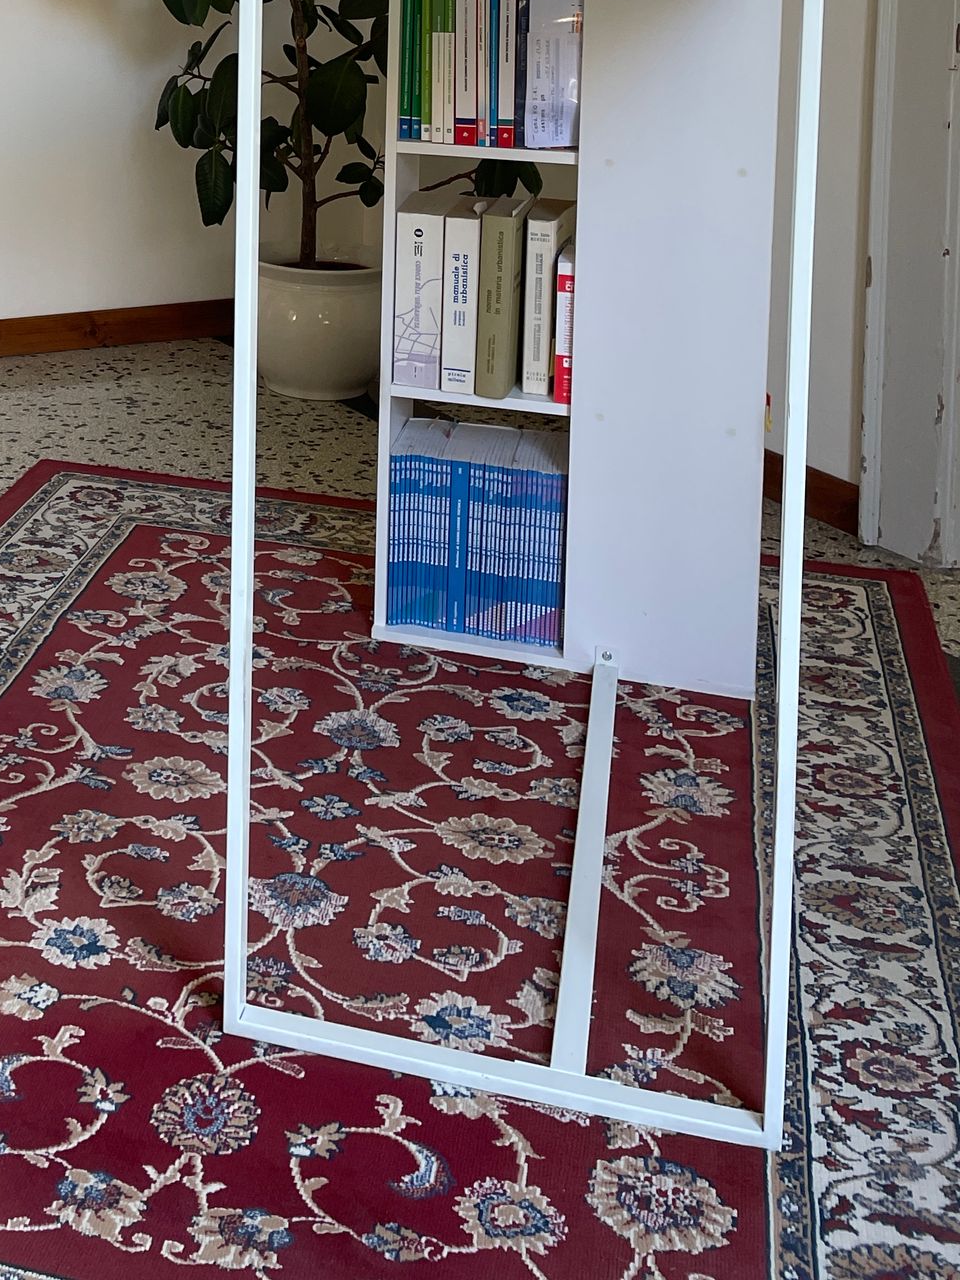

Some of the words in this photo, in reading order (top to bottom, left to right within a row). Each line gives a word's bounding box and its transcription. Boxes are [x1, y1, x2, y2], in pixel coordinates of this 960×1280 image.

[453, 253, 460, 262] di
[496, 231, 504, 272] urbanistica
[452, 266, 460, 304] manuale
[460, 254, 468, 304] urbanistica
